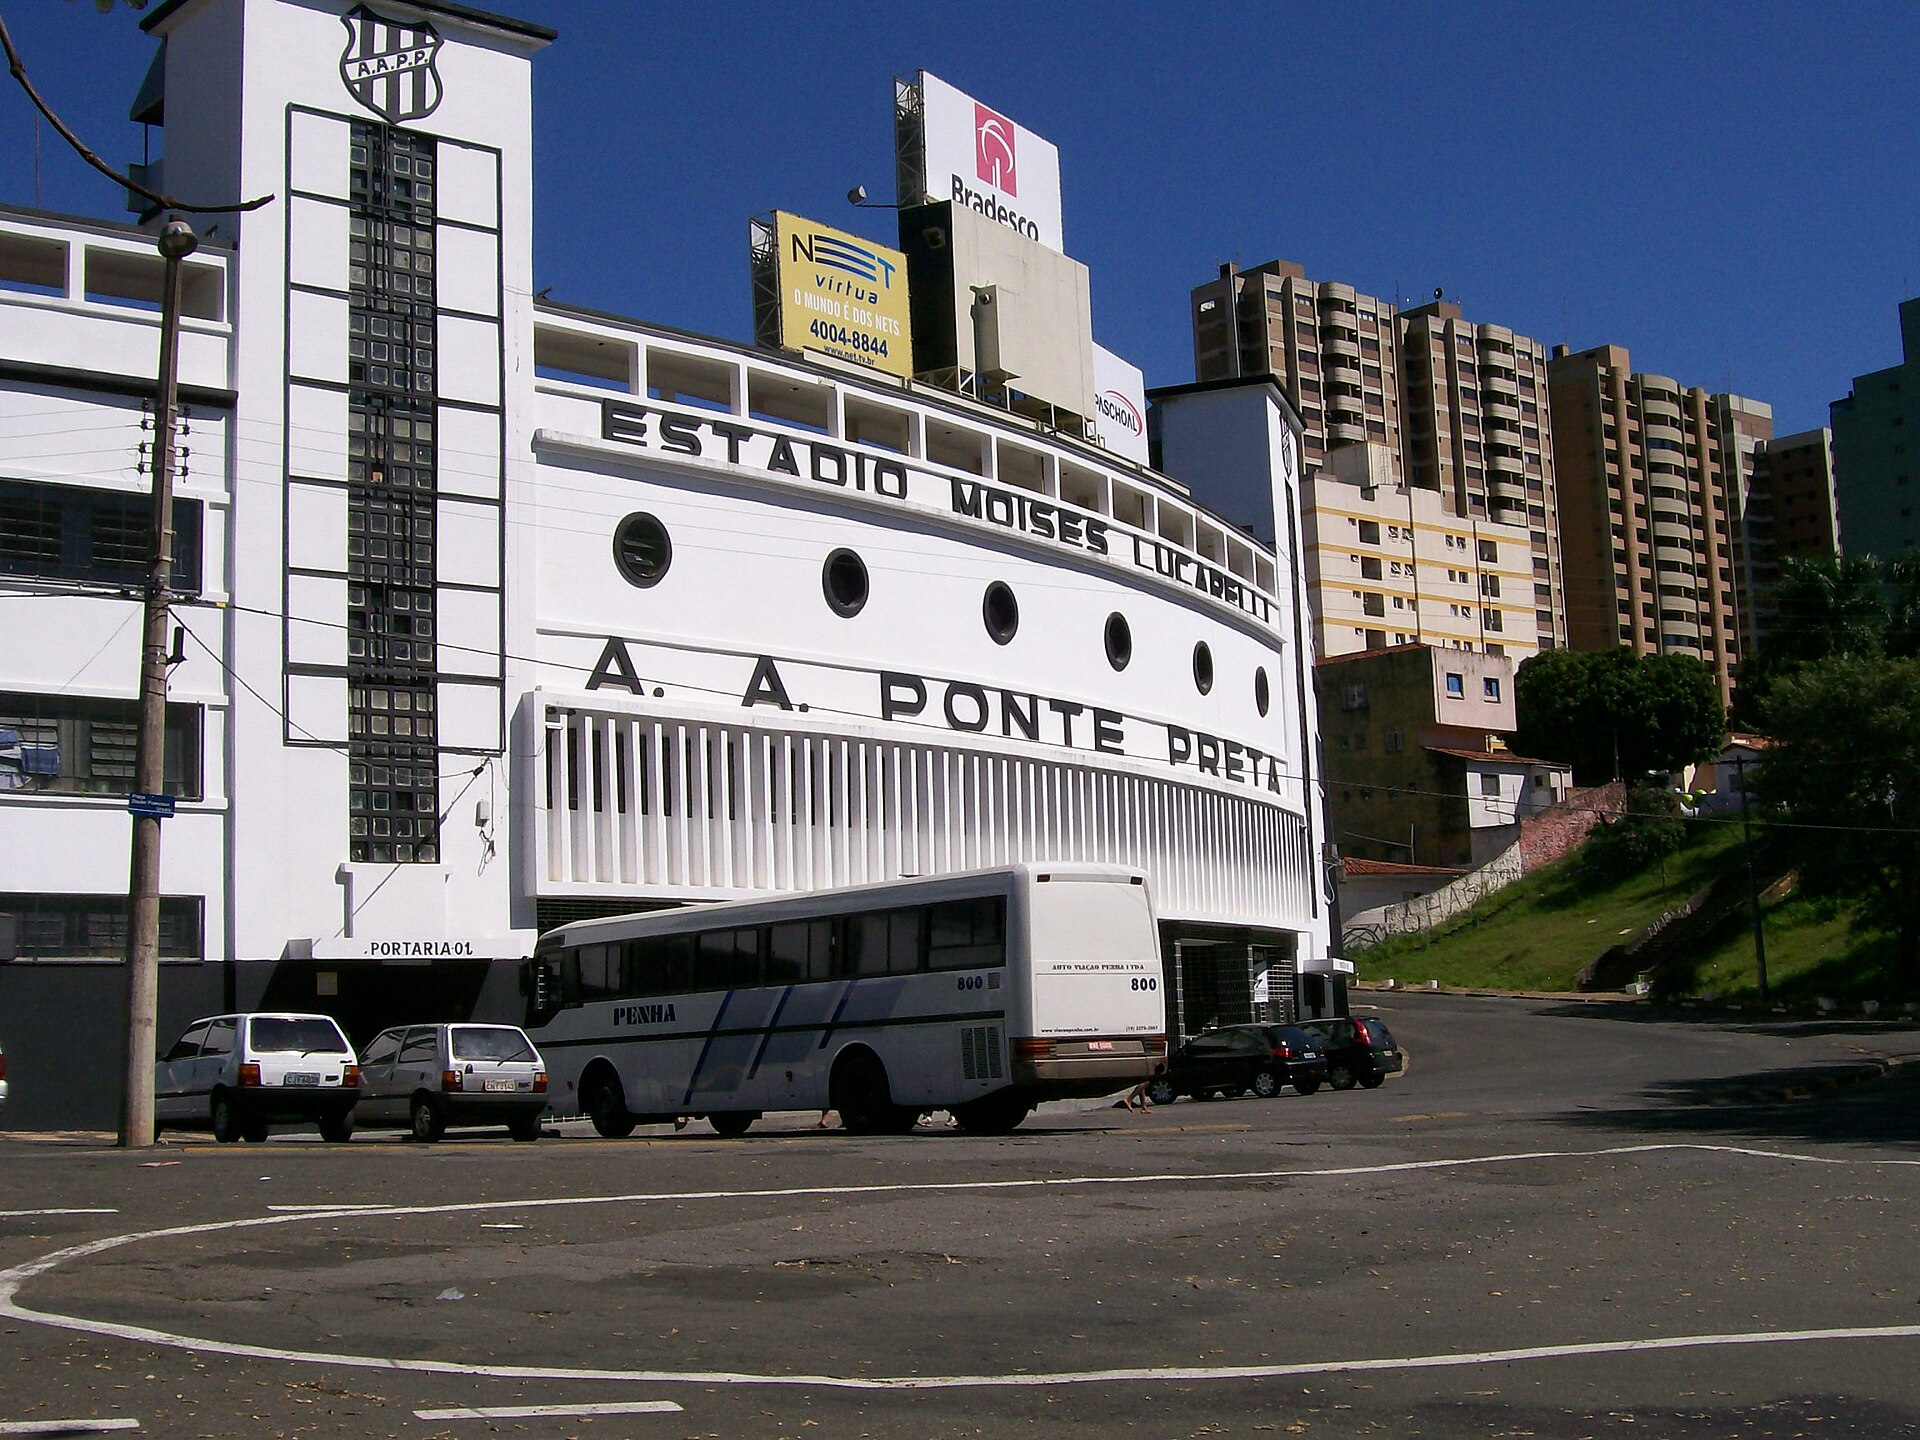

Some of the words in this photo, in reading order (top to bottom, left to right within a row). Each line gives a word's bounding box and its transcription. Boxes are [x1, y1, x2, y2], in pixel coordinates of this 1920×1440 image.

[358, 49, 429, 77] A.A.P.P.
[951, 173, 1039, 242] Bradesco
[792, 233, 896, 290] NET
[794, 288, 801, 305] O
[804, 292, 841, 317] MUNDO
[843, 302, 850, 321] É
[852, 307, 873, 326] DOS
[810, 318, 889, 358] 4004-8844
[823, 344, 875, 367] www.net.tv.br
[601, 399, 908, 500] ESTADIO
[951, 477, 1109, 555] MOISES
[1133, 534, 1269, 624] LUCARELLI
[880, 670, 1125, 756] PONTE
[1166, 723, 1282, 795] PRETA
[957, 976, 983, 990] 800
[1131, 977, 1157, 991] 800
[613, 1003, 676, 1026] PENHA
